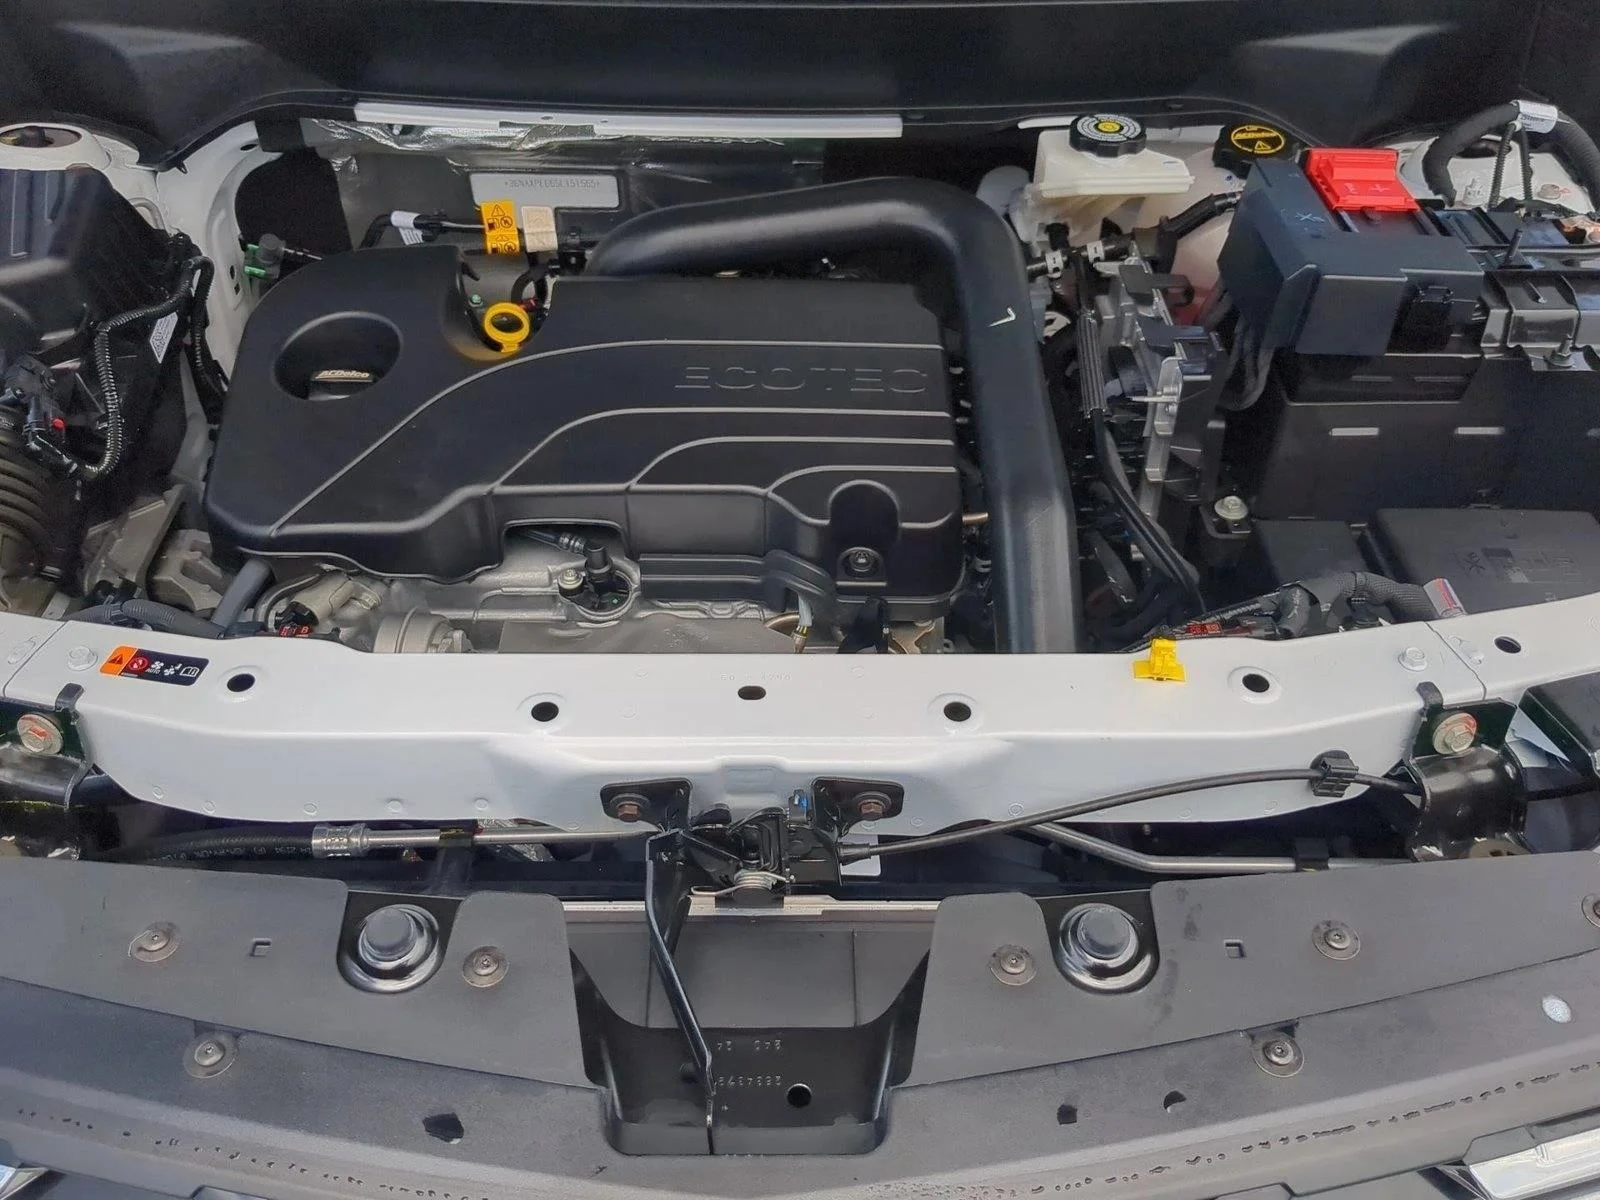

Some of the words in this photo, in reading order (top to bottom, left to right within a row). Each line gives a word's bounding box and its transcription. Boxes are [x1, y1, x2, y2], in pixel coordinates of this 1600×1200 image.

[317, 369, 371, 379] ACDelco
[674, 366, 928, 394] ECOTEC
[145, 667, 161, 675] AUTO
